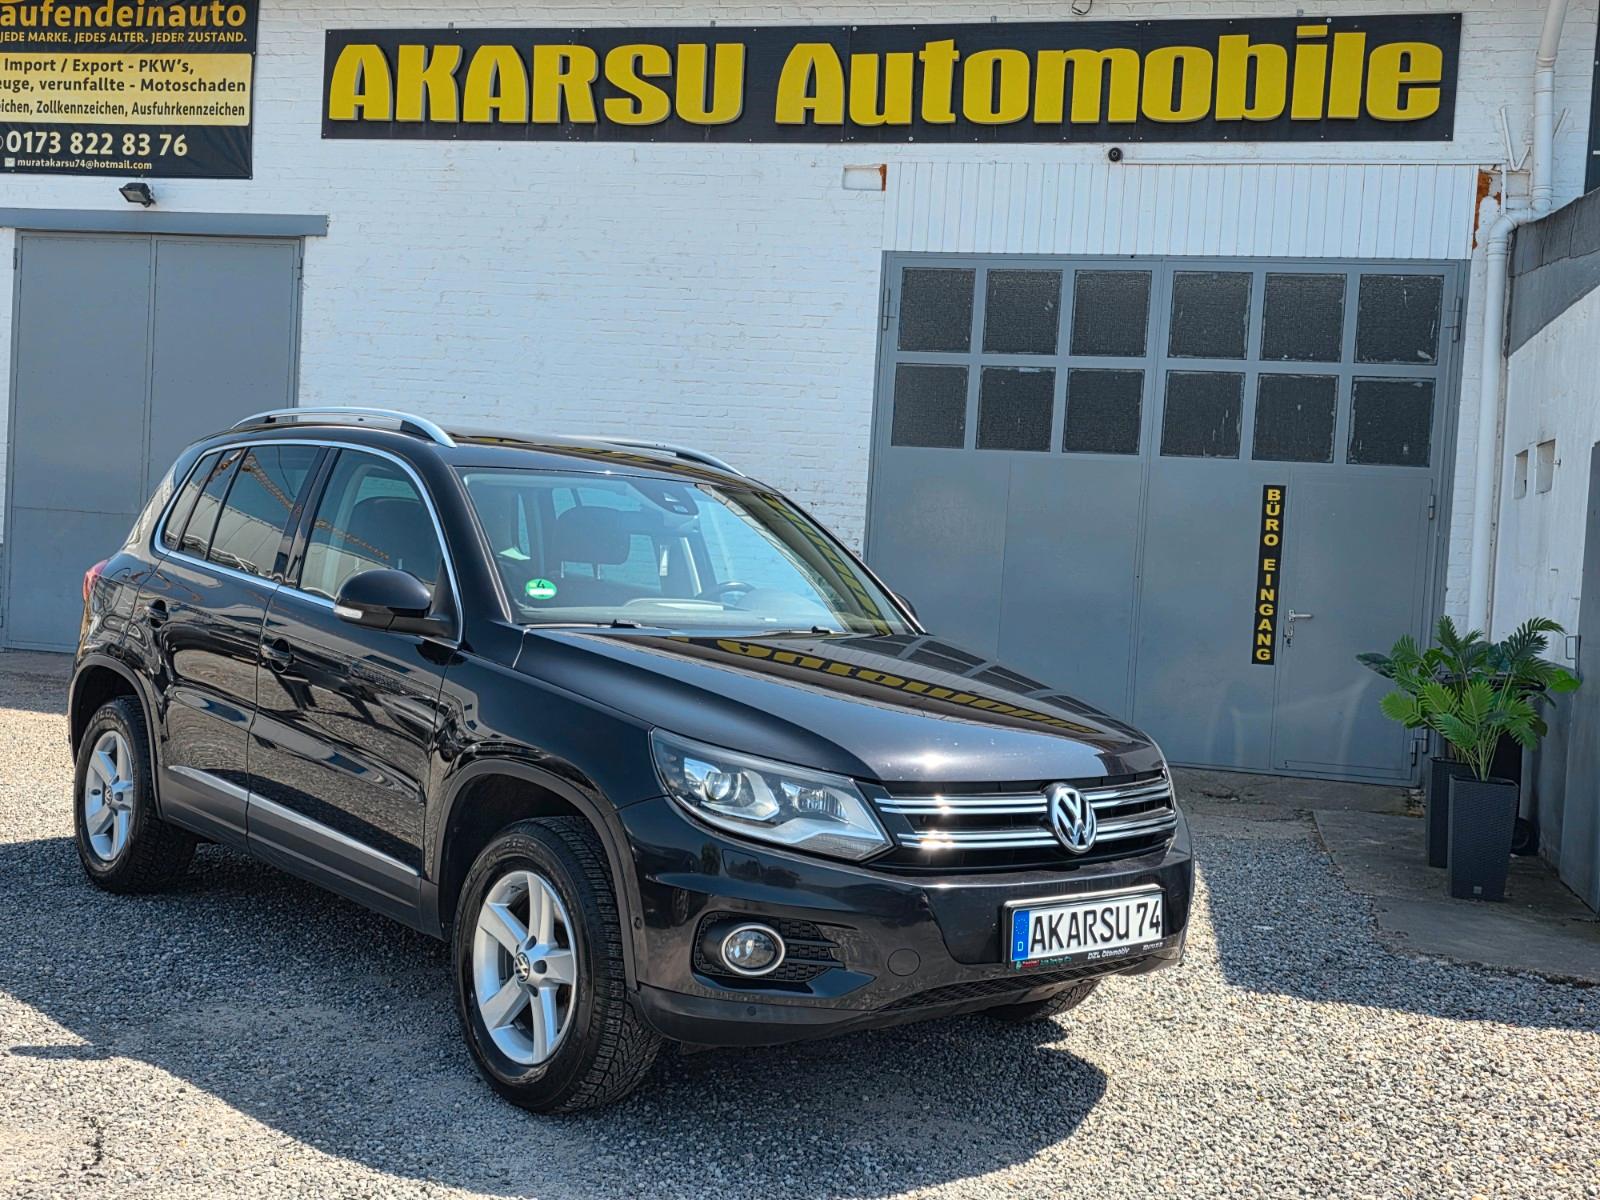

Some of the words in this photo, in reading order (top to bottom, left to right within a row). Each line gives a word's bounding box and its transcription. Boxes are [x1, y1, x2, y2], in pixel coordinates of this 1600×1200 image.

[0, 31, 25, 43] JEDE
[28, 32, 71, 42] MARKE.
[74, 32, 106, 44] JEDES
[109, 32, 148, 43] ALTER.
[151, 32, 185, 44] JEDER
[188, 32, 247, 43] ZUSTAND.
[4, 58, 56, 75] Import
[72, 59, 123, 75] Export
[328, 43, 745, 125] AKARSU
[775, 25, 1443, 125] Automobile
[0, 80, 34, 94] uge,
[39, 77, 125, 92] verunfallte
[140, 78, 246, 92] Motoschaden
[0, 99, 33, 115] ichen,
[36, 100, 128, 117] Zollkennzeichen,
[131, 102, 245, 116] Ausfuhrkennzeichen
[6, 130, 61, 154] 0173
[70, 132, 113, 155] 822
[122, 133, 150, 156] 83
[159, 134, 188, 157] 76
[17, 157, 152, 170] muratakarsu74@hotmail.com
[1264, 489, 1281, 546] BÜRO
[1256, 559, 1276, 660] EINGANG
[1030, 905, 1130, 953] AKARSU
[1136, 900, 1161, 937] 74
